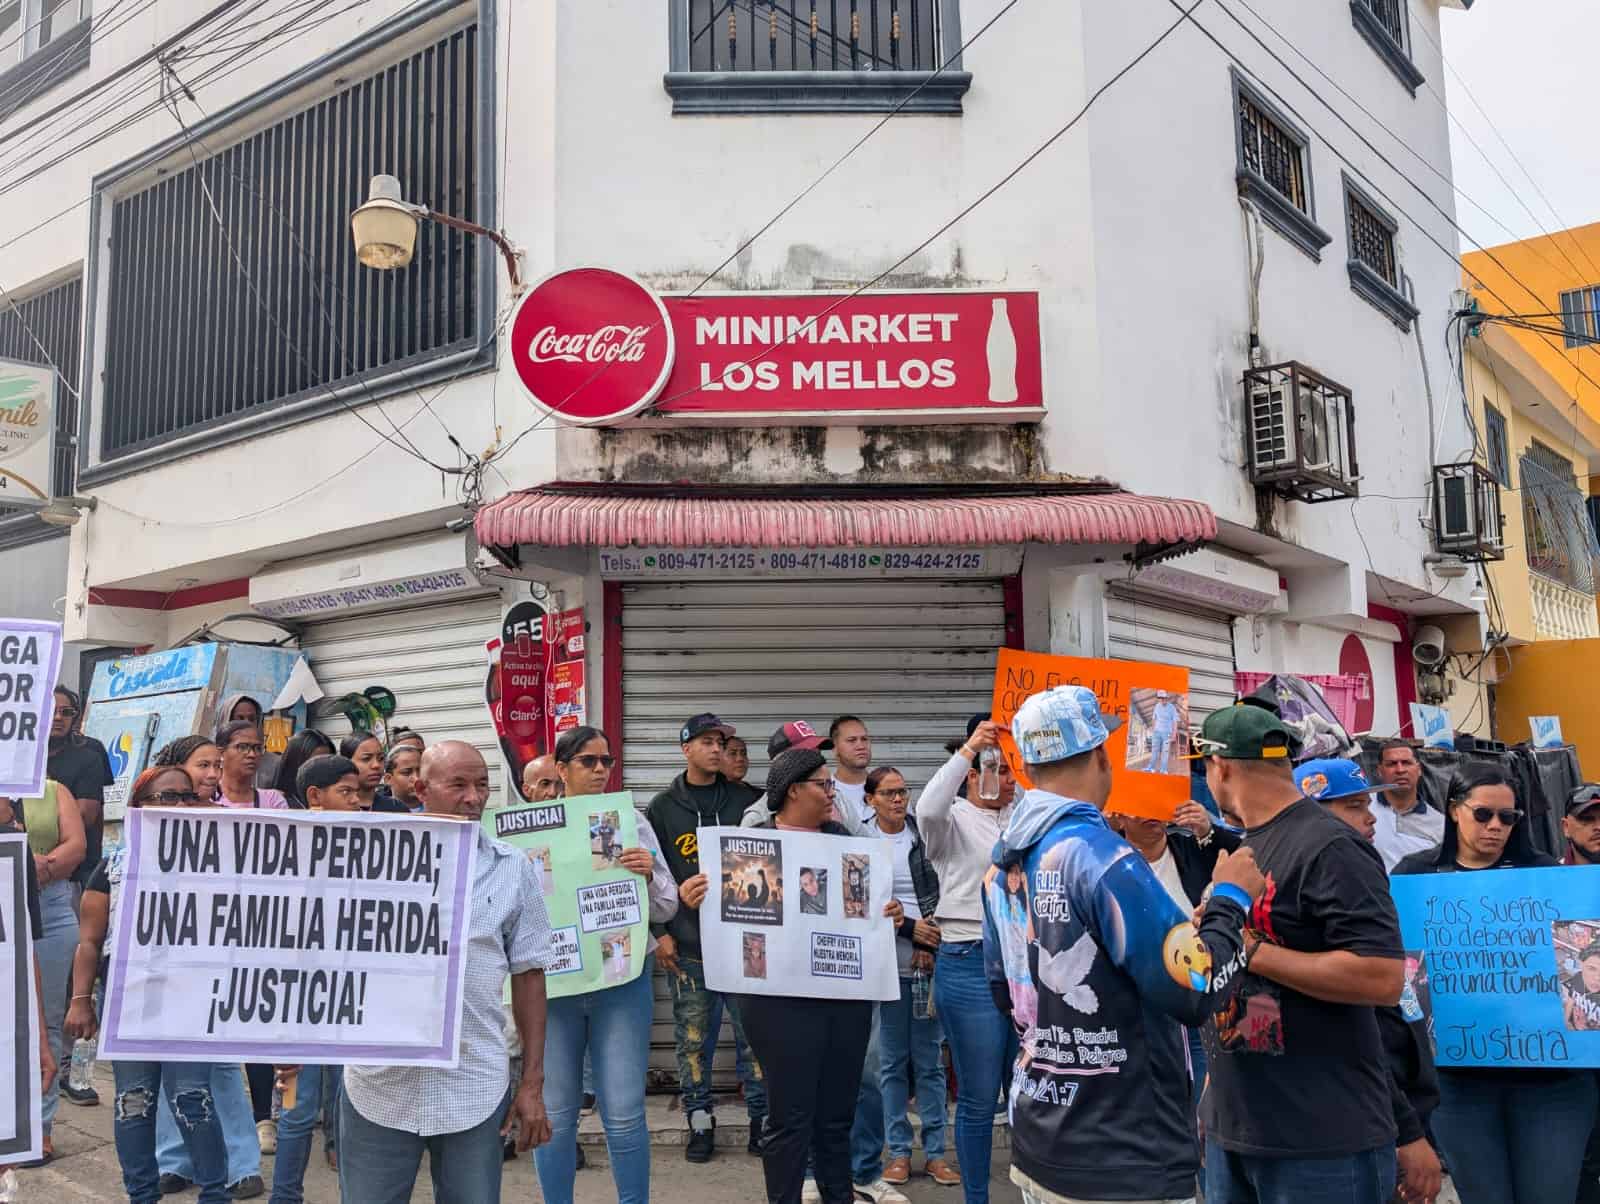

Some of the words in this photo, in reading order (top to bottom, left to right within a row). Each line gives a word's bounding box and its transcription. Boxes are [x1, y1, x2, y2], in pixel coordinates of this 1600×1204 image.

[695, 313, 959, 346] MINIMARKET
[700, 361, 781, 391] LOS
[791, 357, 957, 391] MELLOS
[658, 552, 755, 569] 809-471-2125
[770, 552, 867, 569] 809-471-4818
[884, 553, 981, 570] 829-424-2125
[1006, 666, 1034, 690] NO
[158, 818, 220, 873] UNA
[233, 821, 298, 876] VIDA
[309, 826, 443, 896] PERDIDA;
[725, 838, 776, 856] JUSTICIA
[136, 890, 198, 946] UNA
[208, 893, 325, 951] FAMILIA
[335, 897, 448, 956] HERIDA.
[1424, 896, 1473, 926] Los
[1424, 927, 1452, 947] no
[1429, 948, 1536, 972] terminar
[206, 966, 368, 1034] ¡JUSTICIA!
[1445, 1021, 1570, 1063] Justicia
